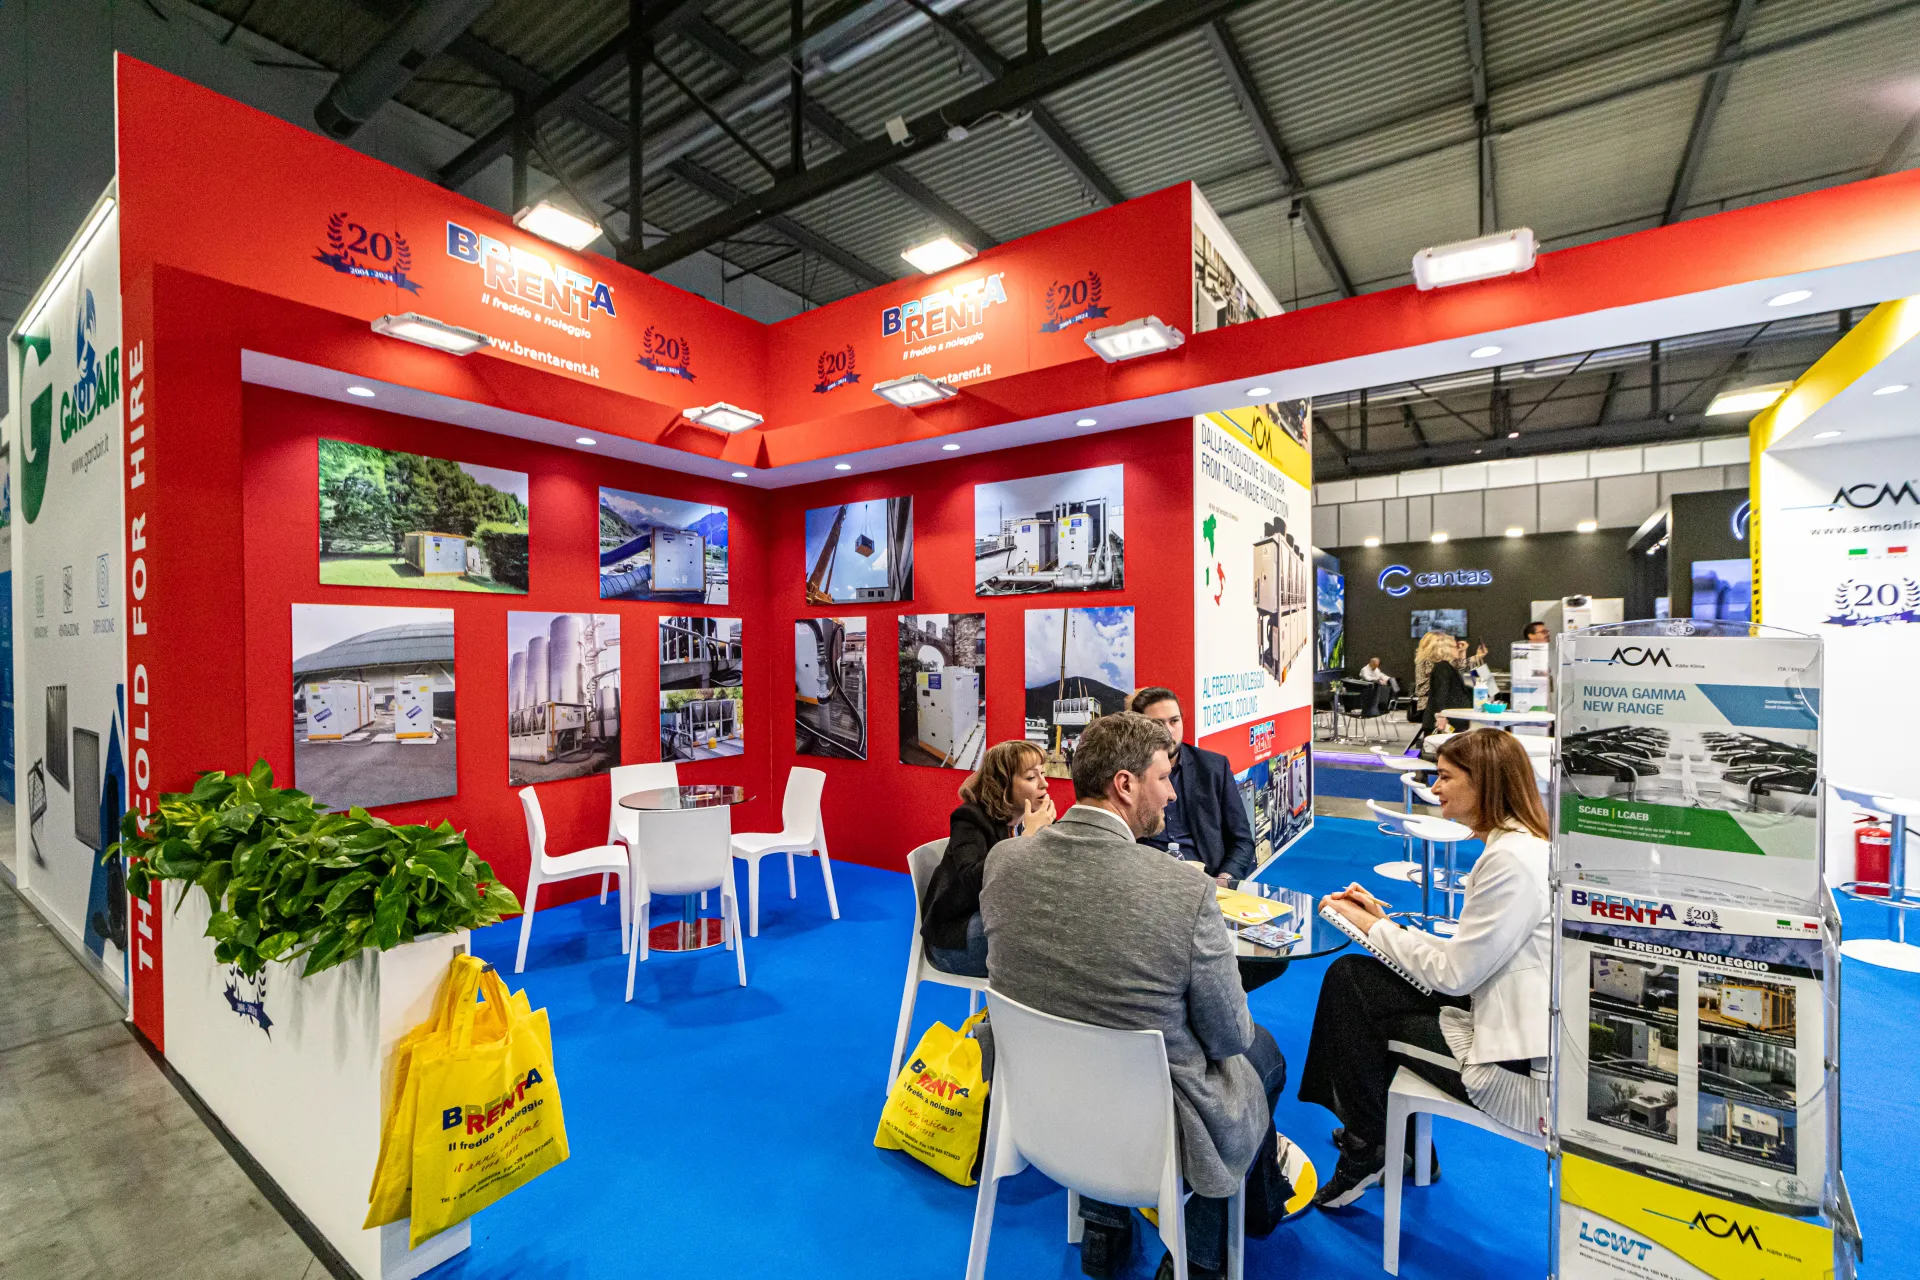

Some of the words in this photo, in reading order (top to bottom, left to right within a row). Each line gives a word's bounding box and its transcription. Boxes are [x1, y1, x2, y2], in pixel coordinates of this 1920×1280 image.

[348, 223, 393, 262] 20
[350, 266, 370, 277] 2004
[447, 221, 617, 318] BRENTA
[484, 255, 597, 323] RENT
[1058, 280, 1088, 310] 20
[481, 292, 490, 304] Il
[492, 299, 532, 320] freddo
[534, 313, 542, 323] a
[544, 317, 592, 339] noleggio
[904, 298, 984, 344] RENT
[487, 336, 600, 379] ww.brentarent.it
[654, 334, 680, 360] 20
[903, 350, 909, 360] Il
[910, 344, 937, 359] freddo
[938, 343, 944, 351] a
[946, 332, 984, 350] noleggio
[826, 352, 847, 375] 20
[129, 340, 145, 489] HIRE
[1201, 422, 1223, 456] DALLA
[1224, 439, 1259, 480] PRODUZIONE
[1249, 413, 1273, 460] ACM
[1201, 451, 1221, 483] FROM
[1222, 464, 1259, 504] TAILOR-MADE
[1260, 487, 1289, 519] PRODUCTION
[1829, 480, 1920, 513] ACM
[131, 512, 148, 636] FOR
[1414, 568, 1493, 588] cantas
[1854, 583, 1899, 606] 20
[1608, 646, 1672, 668] ACM
[1203, 677, 1211, 699] AL
[1212, 673, 1235, 696] FREDDO
[1241, 669, 1265, 690] NOLEGGIO
[1583, 686, 1628, 699] NUOVA
[1632, 688, 1686, 701] GAMMA
[1203, 706, 1211, 727] TO
[1213, 701, 1235, 724] RENTAL
[1236, 694, 1258, 718] COOLING
[1583, 701, 1614, 713] NEW
[1618, 703, 1664, 715] RANGE
[1578, 805, 1609, 817] SCAEB
[1617, 810, 1649, 821] LCAEB
[1571, 889, 1677, 921] BRENTA
[1591, 900, 1662, 926] RENT
[1694, 910, 1711, 920] 20
[1613, 938, 1625, 948] IL
[1629, 941, 1682, 957] FREDDO
[1685, 951, 1694, 960] A
[1698, 953, 1769, 972] NOLEGGIO
[910, 1058, 970, 1098] BRENTA
[916, 1073, 961, 1101] RENT
[442, 1067, 543, 1131] BRENTA
[467, 1080, 528, 1135] RENT
[930, 1100, 963, 1117] noleggio
[448, 1142, 456, 1151] Il
[460, 1132, 495, 1149] freddo
[505, 1099, 544, 1127] noleggio
[1579, 1222, 1653, 1260] LCWT
[1689, 1211, 1763, 1251] ACM
